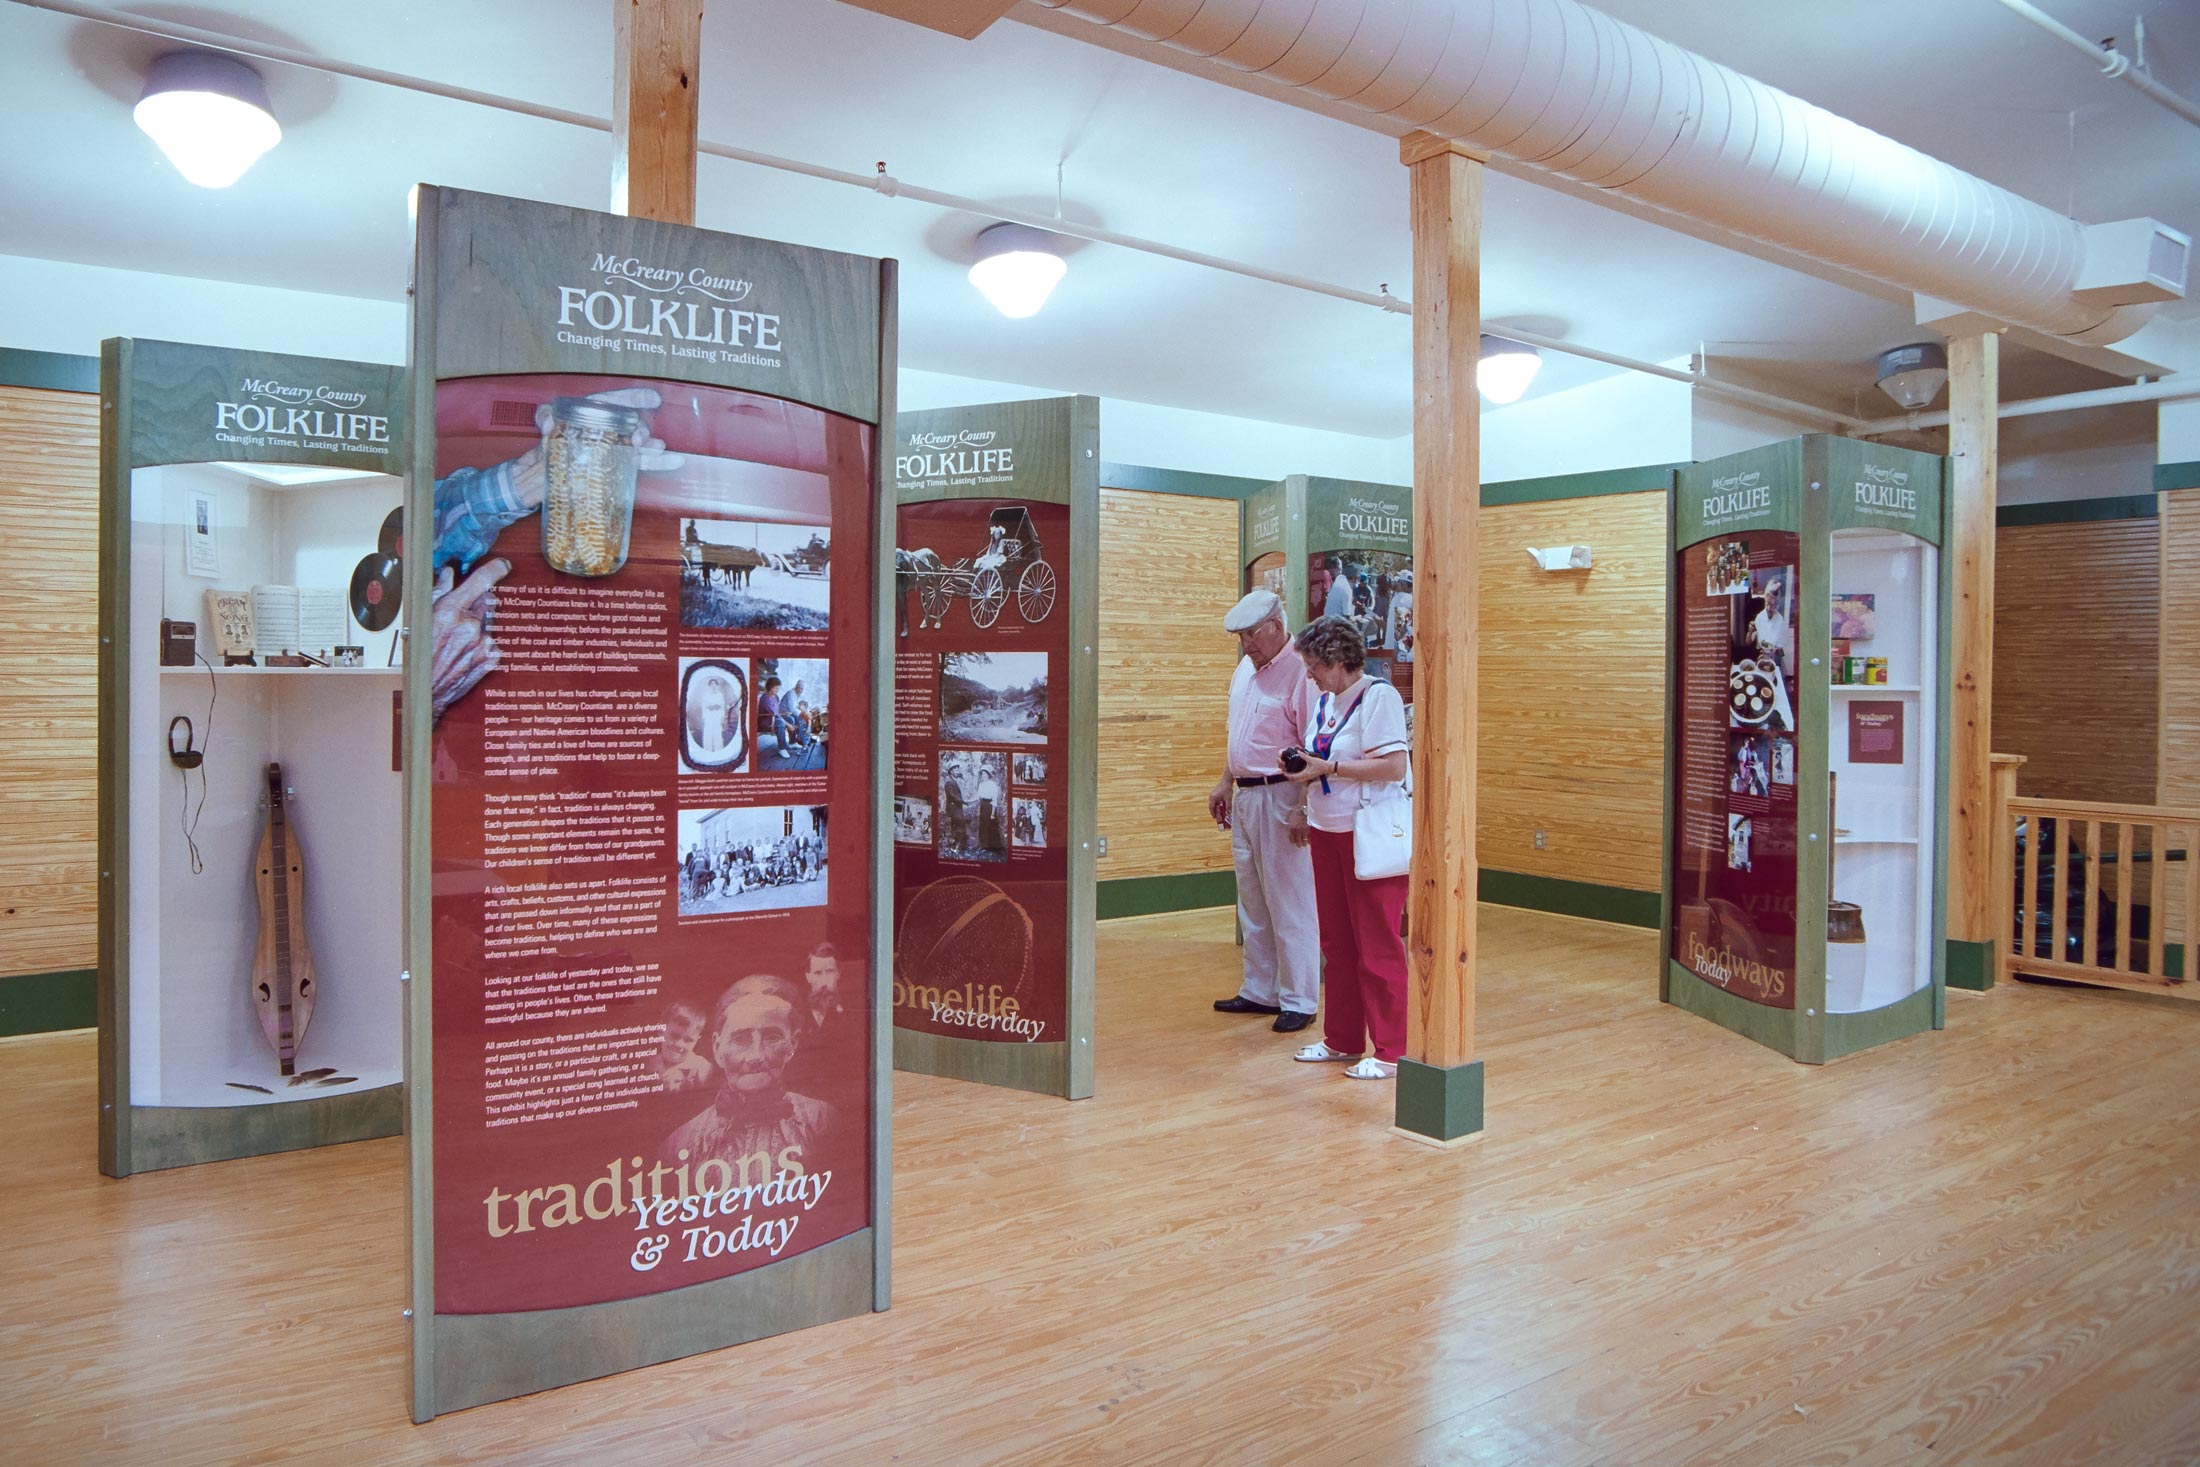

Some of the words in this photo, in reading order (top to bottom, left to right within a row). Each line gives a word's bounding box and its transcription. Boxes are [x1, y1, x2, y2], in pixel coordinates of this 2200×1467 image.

[590, 253, 684, 295] McCreary
[688, 267, 753, 302] County
[557, 286, 781, 352] FOLKLIFE
[557, 331, 620, 353] Changing
[624, 338, 667, 355] Times,
[671, 345, 717, 363] Lasting
[720, 350, 781, 368] Traditions
[241, 378, 313, 404] McCreary
[316, 385, 366, 409] County
[216, 401, 390, 442] FOLKLIFE
[216, 432, 264, 447] Changing
[267, 436, 300, 448] Times,
[303, 440, 338, 453] Lasting
[341, 442, 389, 454] Traditions
[909, 432, 957, 451] McCreary
[959, 429, 996, 447] County
[897, 448, 1014, 478] FOLKLIFE
[951, 477, 976, 486] Lasting
[978, 474, 1013, 484] Traditions
[1703, 486, 1771, 517] FOLKLIFE
[1855, 482, 1916, 510] FOLKLIFE
[1339, 513, 1409, 536] FOLKLIFE
[485, 977, 511, 986] Looking
[535, 973, 558, 981] folklife
[560, 971, 566, 979] of
[568, 969, 600, 979] yesterday
[602, 967, 613, 975] and
[1688, 931, 1786, 998] foodways
[1694, 953, 1732, 987] Today
[485, 1002, 515, 1012] meaning
[525, 998, 553, 1008] people's
[615, 989, 645, 998] traditions
[485, 1014, 523, 1025] meaningful
[526, 1011, 553, 1020] because
[555, 1009, 569, 1017] they
[929, 1001, 1046, 1043] Yesterday
[486, 1092, 522, 1103] community
[562, 1082, 585, 1093] special
[587, 1081, 602, 1089] song
[605, 1077, 628, 1086] learned
[505, 1077, 528, 1087] Maybe
[531, 1075, 541, 1083] it's
[553, 1071, 575, 1080] annual
[577, 1068, 596, 1078] family
[486, 1106, 500, 1114] This
[502, 1103, 525, 1112] exhibit
[527, 1098, 560, 1109] highlights
[562, 1097, 574, 1106] just
[582, 1093, 594, 1101] few
[604, 1090, 614, 1098] the
[616, 1086, 650, 1096] individuals
[652, 1084, 663, 1092] and
[486, 1117, 518, 1127] traditions
[520, 1114, 534, 1122] that
[536, 1112, 554, 1120] make
[556, 1110, 564, 1119] up
[578, 1105, 601, 1114] diverse
[483, 1143, 805, 1239] traditions
[630, 1169, 832, 1232] Yesterday
[630, 1233, 670, 1272] &
[681, 1215, 799, 1264] Today
